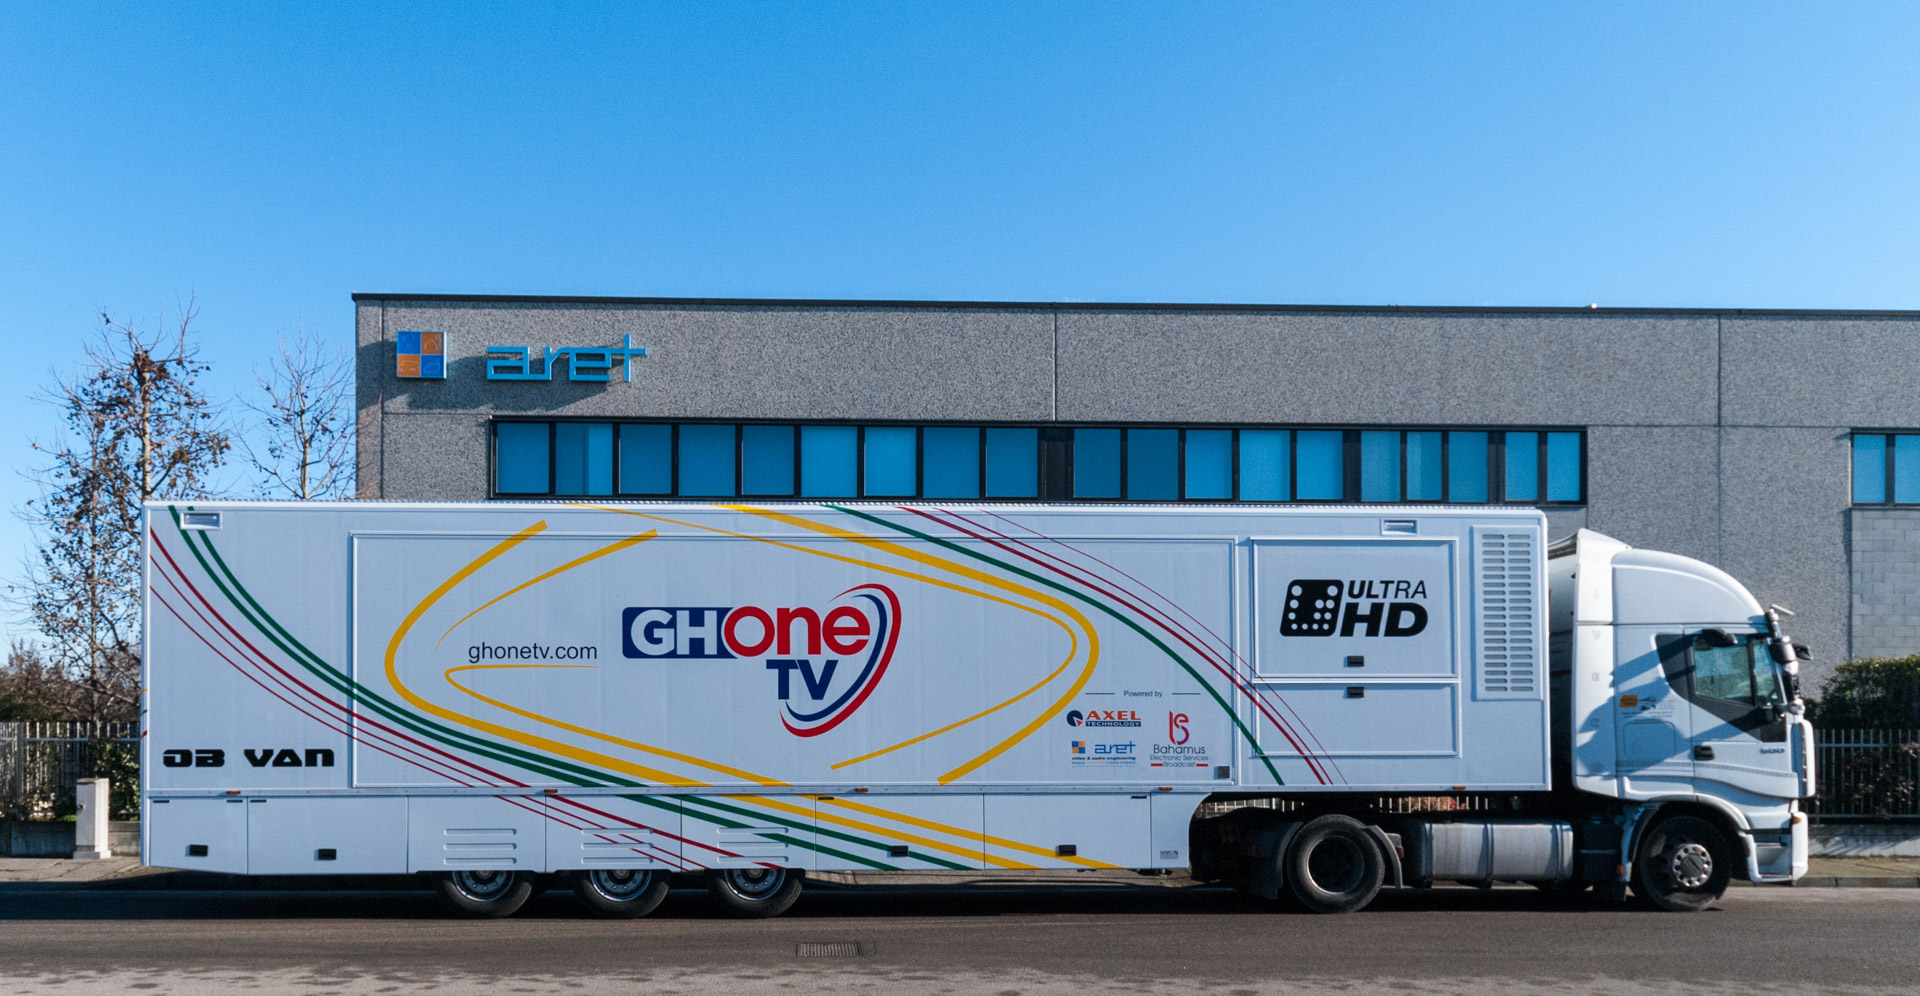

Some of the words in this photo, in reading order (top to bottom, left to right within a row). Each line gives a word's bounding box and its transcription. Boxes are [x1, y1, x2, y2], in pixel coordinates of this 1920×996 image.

[486, 333, 648, 382] aret
[1347, 580, 1427, 599] ULTRA
[1339, 602, 1429, 637] HD
[468, 641, 598, 664] ghonetv.com
[766, 659, 839, 700] TV
[1154, 690, 1163, 698] by
[1086, 710, 1142, 721] AXEL
[1094, 740, 1137, 754] aret
[1153, 744, 1206, 755] Bahamus
[163, 748, 225, 768] OB
[243, 748, 335, 767] VAN
